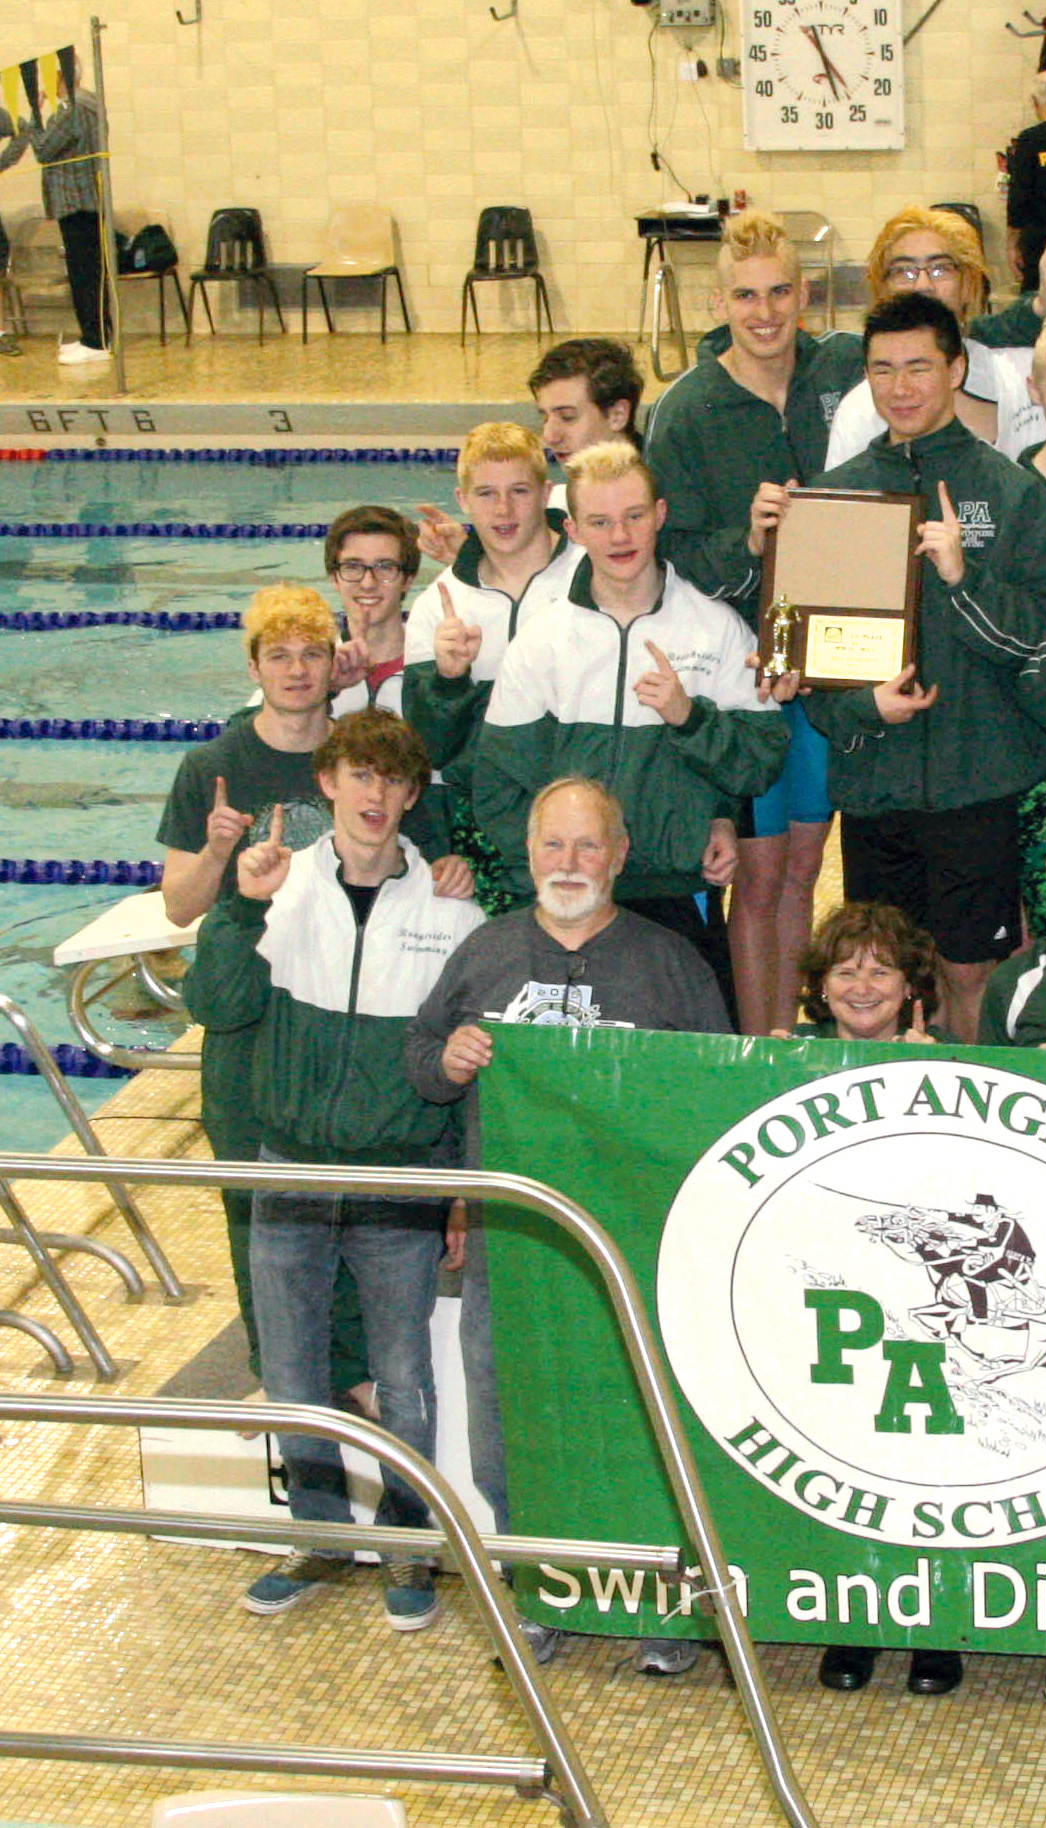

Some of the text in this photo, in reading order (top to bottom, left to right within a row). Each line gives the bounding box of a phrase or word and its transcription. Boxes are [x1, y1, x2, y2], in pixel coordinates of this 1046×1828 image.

[754, 10, 772, 28] 50
[874, 8, 888, 26] 10
[817, 24, 845, 36] TYR
[749, 45, 767, 62] 45
[881, 44, 894, 62] 15
[755, 80, 773, 97] 40
[874, 79, 892, 96] 20
[781, 106, 799, 124] 35
[815, 112, 833, 130] 30
[850, 105, 867, 122] 25
[26, 410, 110, 432] 6FT
[268, 410, 293, 432] 3
[957, 501, 991, 523] PA
[718, 1076, 886, 1189] PORT
[723, 1416, 898, 1532] HIGH
[786, 1558, 931, 1628] and
